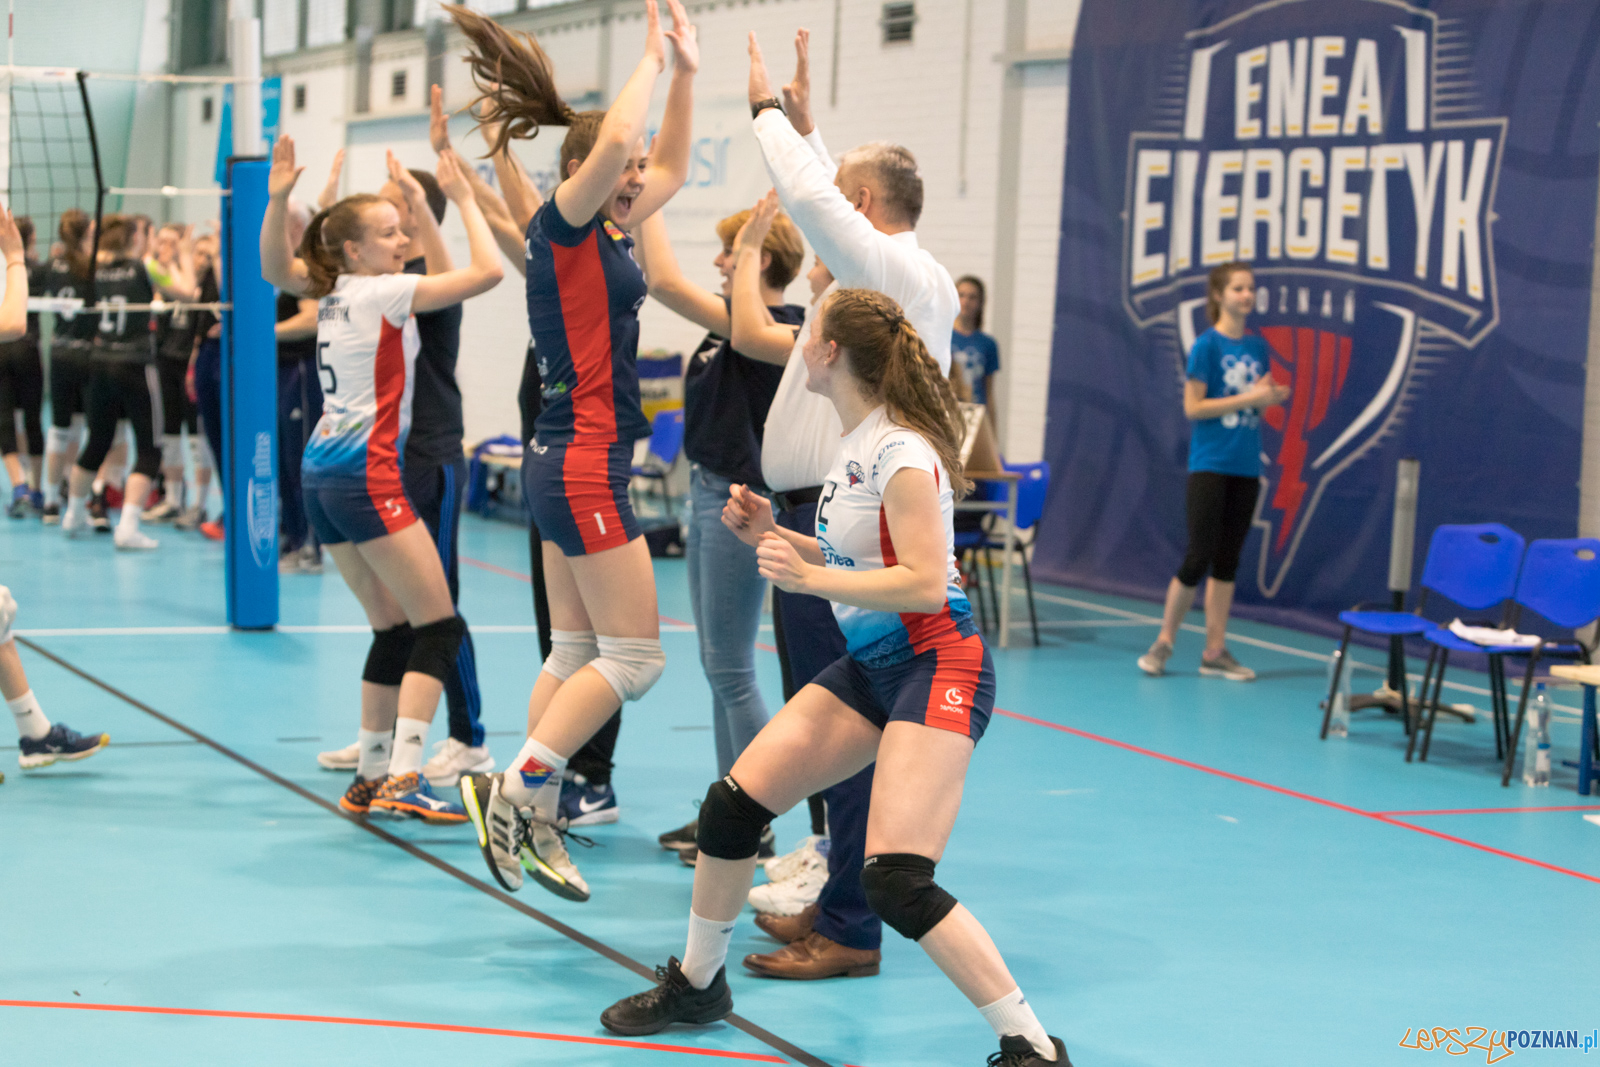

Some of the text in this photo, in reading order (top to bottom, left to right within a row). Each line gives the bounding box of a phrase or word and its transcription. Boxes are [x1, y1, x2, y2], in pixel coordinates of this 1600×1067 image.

[1235, 36, 1383, 139] ENEA
[316, 341, 338, 395] 5
[385, 497, 402, 518] 5
[593, 511, 607, 535] 1
[818, 480, 837, 526] 2
